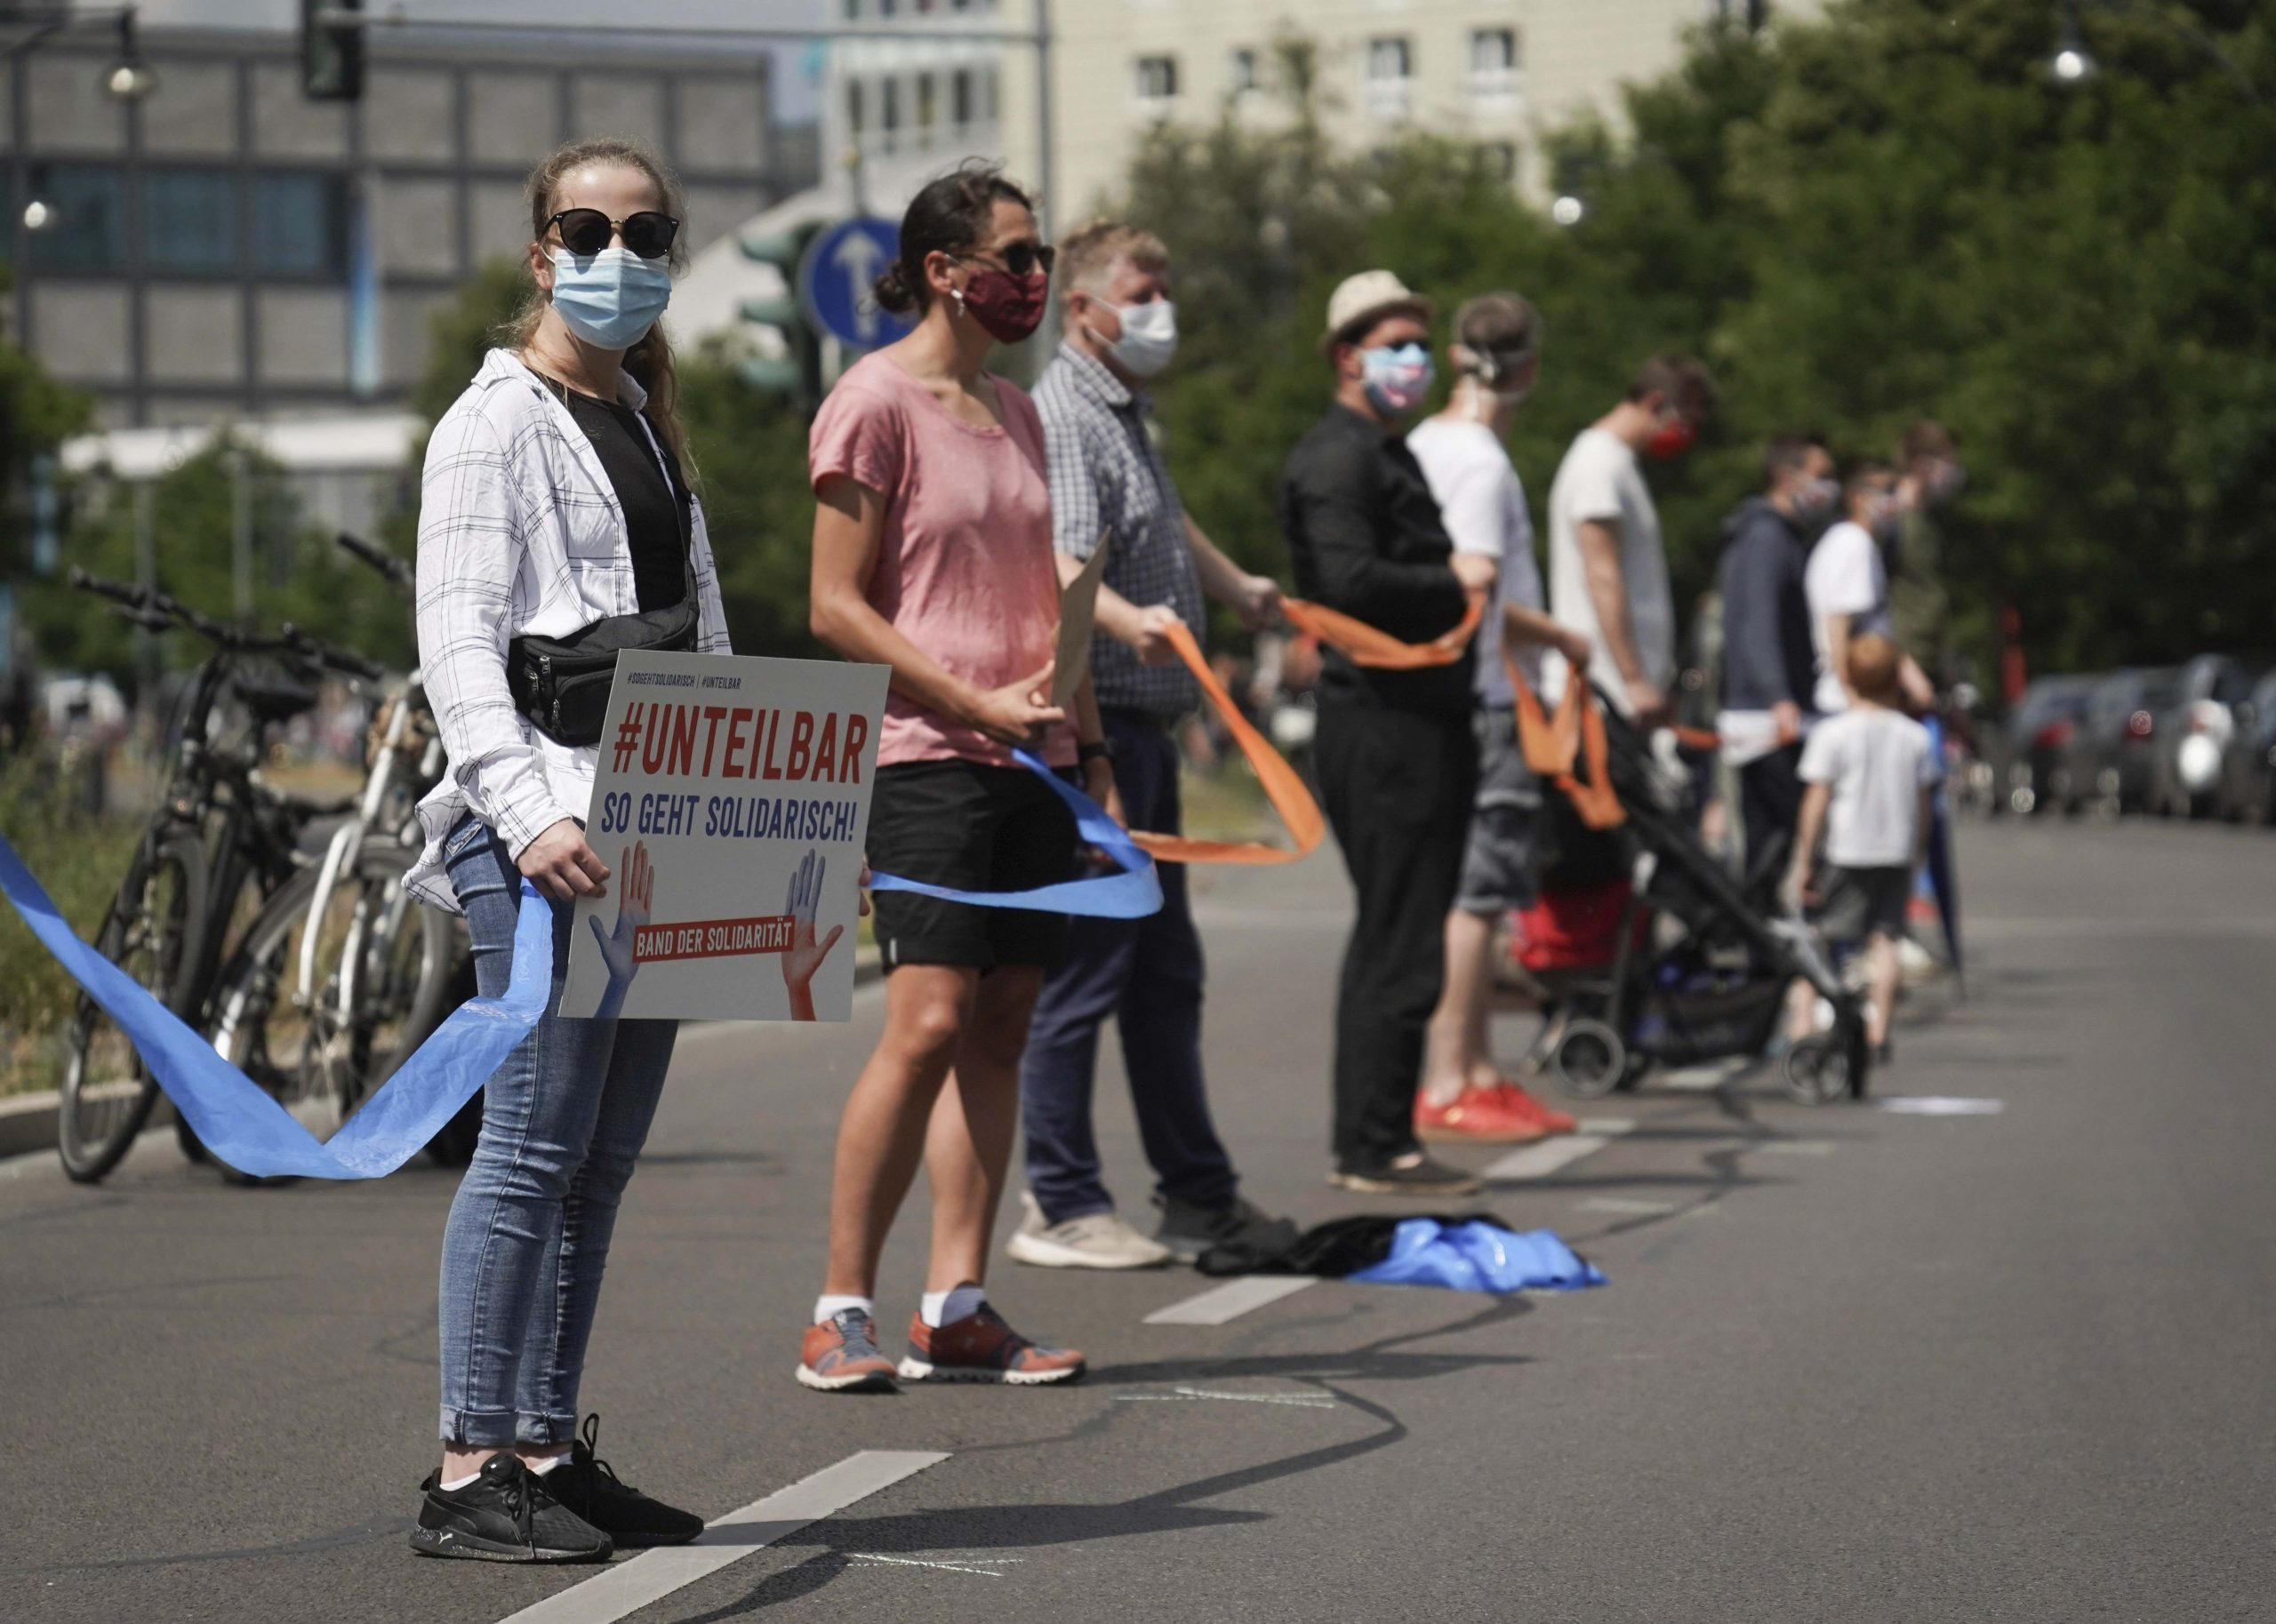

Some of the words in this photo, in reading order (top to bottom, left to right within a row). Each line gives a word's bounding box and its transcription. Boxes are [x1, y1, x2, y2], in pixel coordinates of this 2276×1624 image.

[627, 672, 695, 688] #SOGEHTSOLIDARISCH
[701, 676, 741, 690] #UNTEILBAR
[613, 702, 868, 784] #UNTEILBAR
[601, 791, 632, 833] SO
[638, 794, 701, 836] GEHT
[705, 796, 857, 841] SOLIDARISCH!
[636, 932, 674, 957] BAND
[677, 927, 704, 954] DER
[707, 917, 792, 951] SOLIDARITÄT
